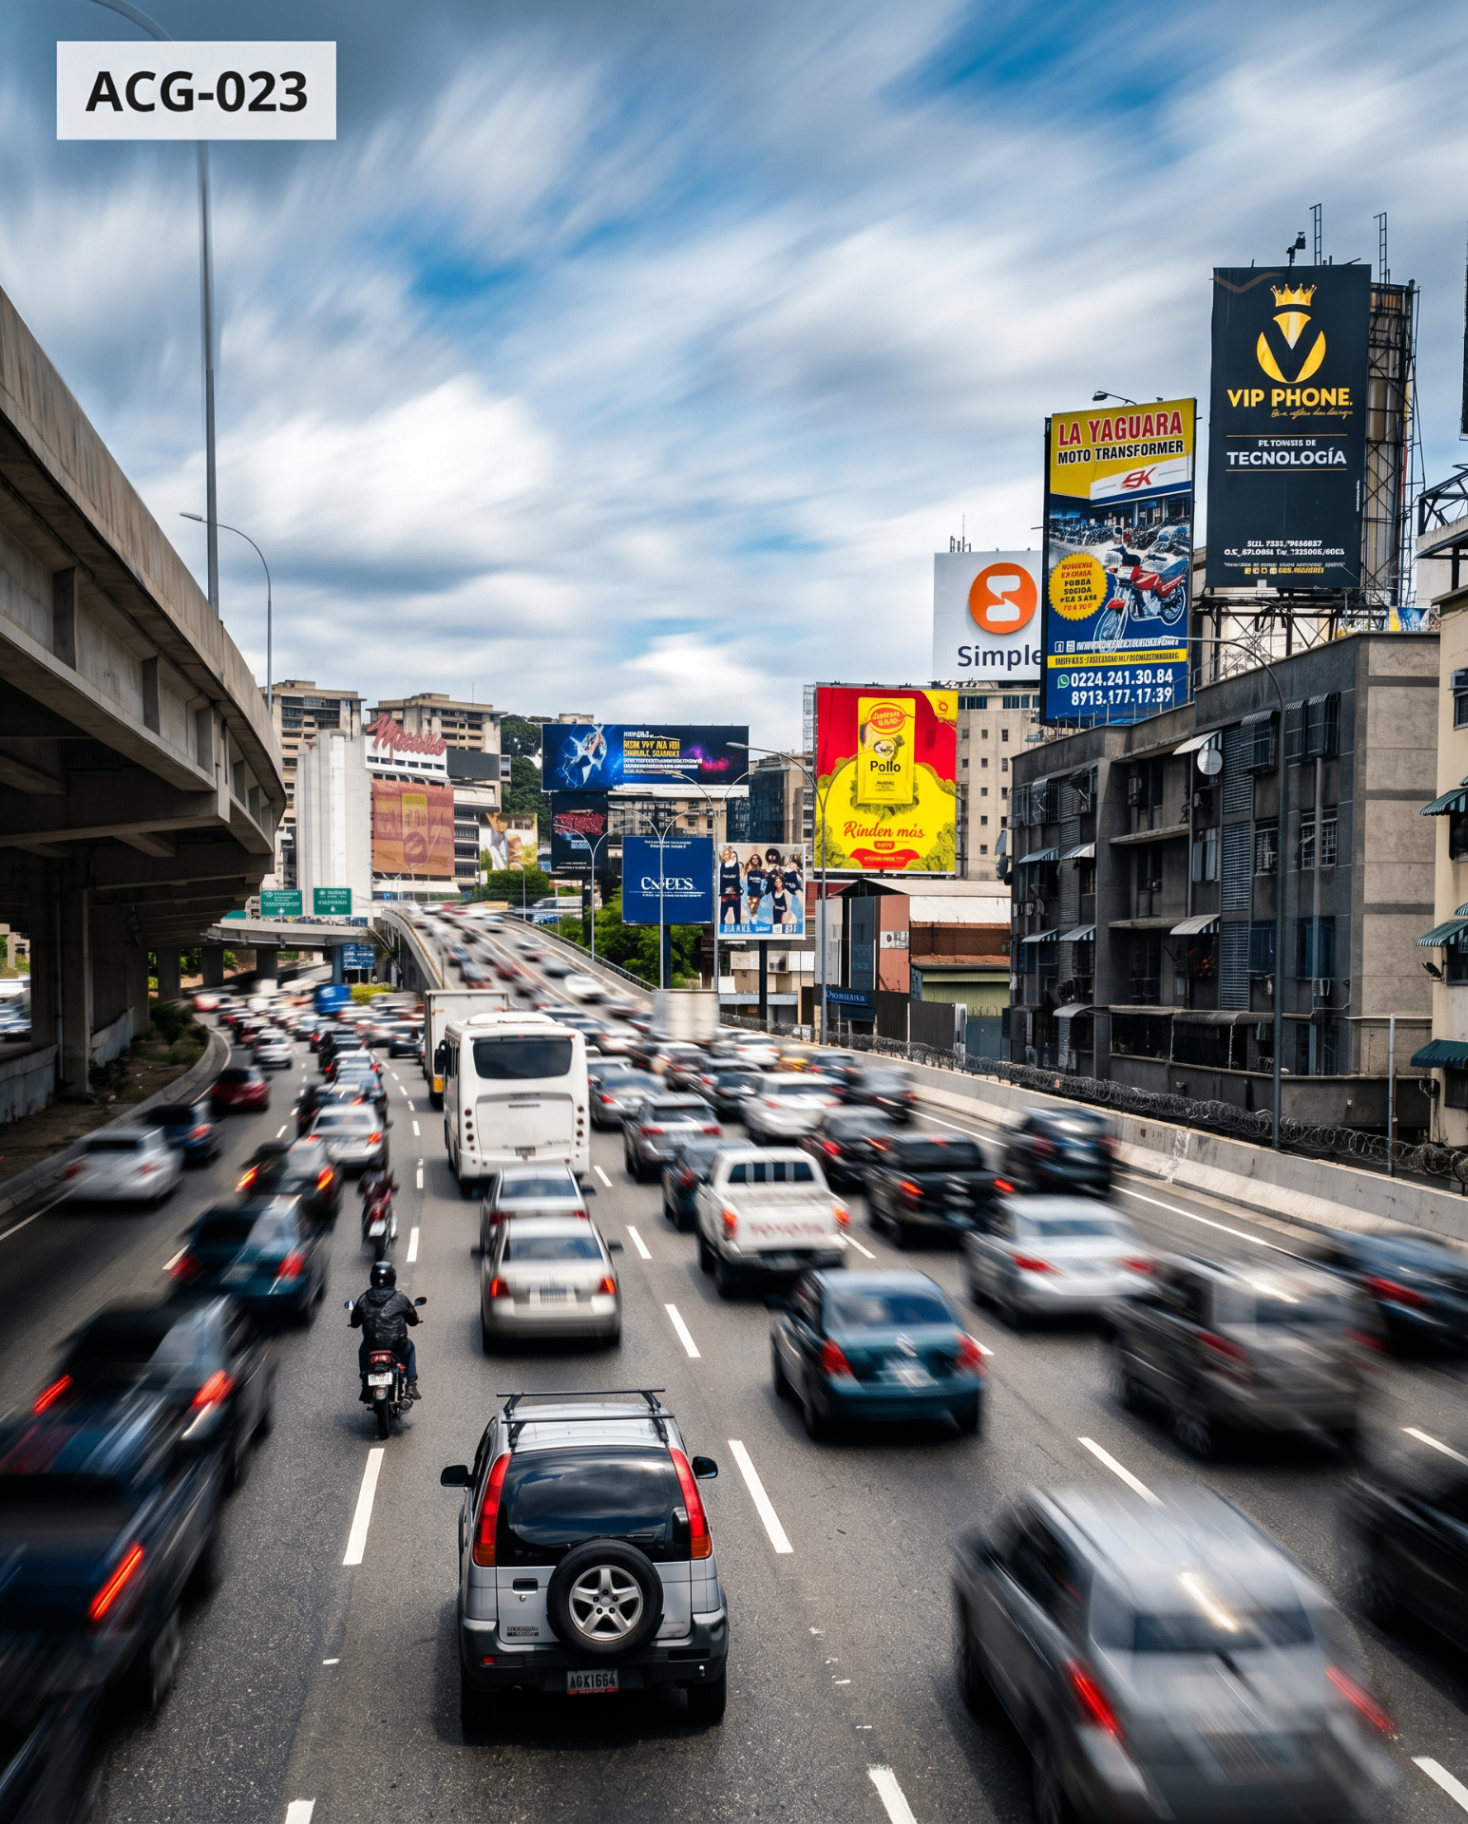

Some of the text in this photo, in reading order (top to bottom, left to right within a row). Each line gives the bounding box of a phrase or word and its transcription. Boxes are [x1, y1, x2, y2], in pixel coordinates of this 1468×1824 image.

[1227, 389, 1264, 407] VIP
[1059, 411, 1183, 446] LA YAGUARA
[1058, 440, 1183, 464] MOTO TRANSFORMER
[1226, 447, 1347, 465] TECNOLOGÍA
[957, 644, 1041, 671] Simple
[1070, 668, 1173, 688] 0224.241.30.84
[870, 760, 901, 772] Pollo
[844, 821, 926, 838] Rinden más
